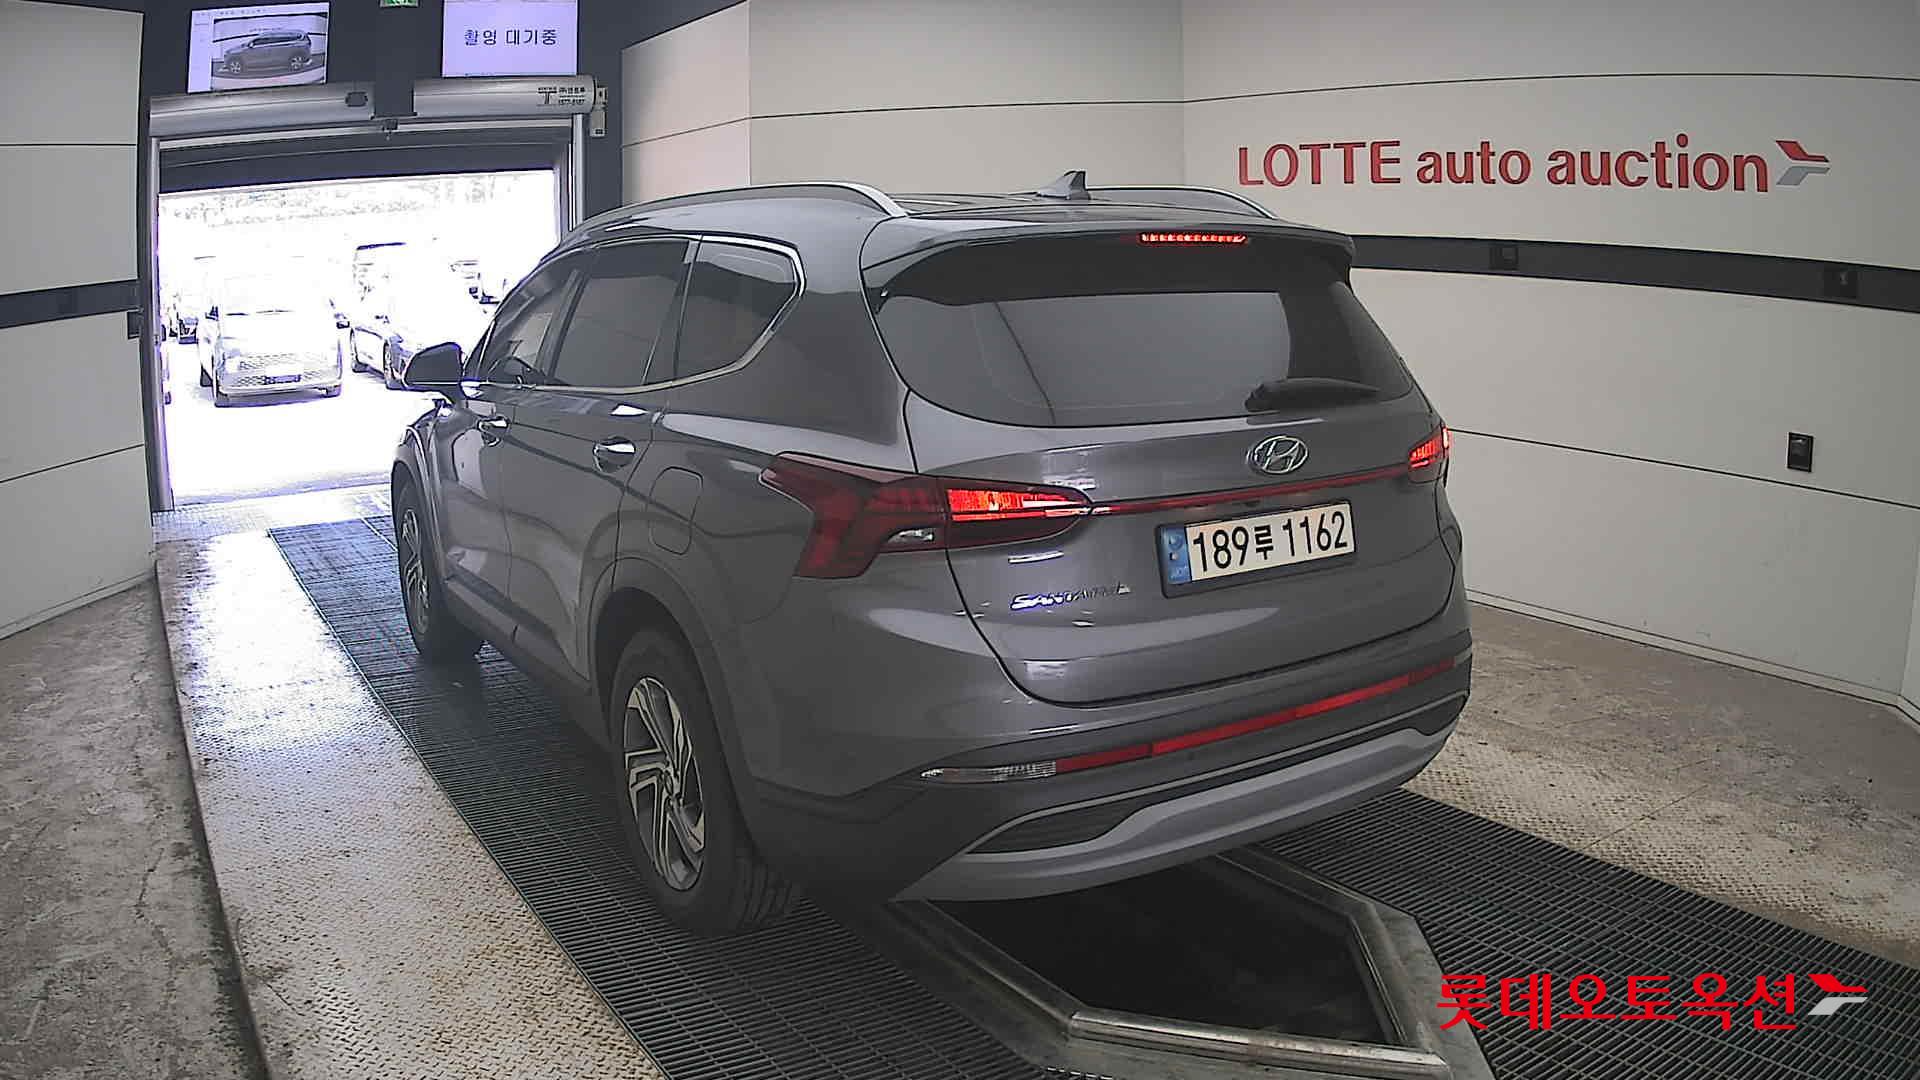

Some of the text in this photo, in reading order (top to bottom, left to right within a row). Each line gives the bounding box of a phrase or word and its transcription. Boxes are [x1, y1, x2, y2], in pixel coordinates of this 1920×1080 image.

[464, 29, 557, 46] 촬영 대기중
[1238, 133, 1769, 193] LOTTE auto auction
[1193, 511, 1348, 572] 189루 1162
